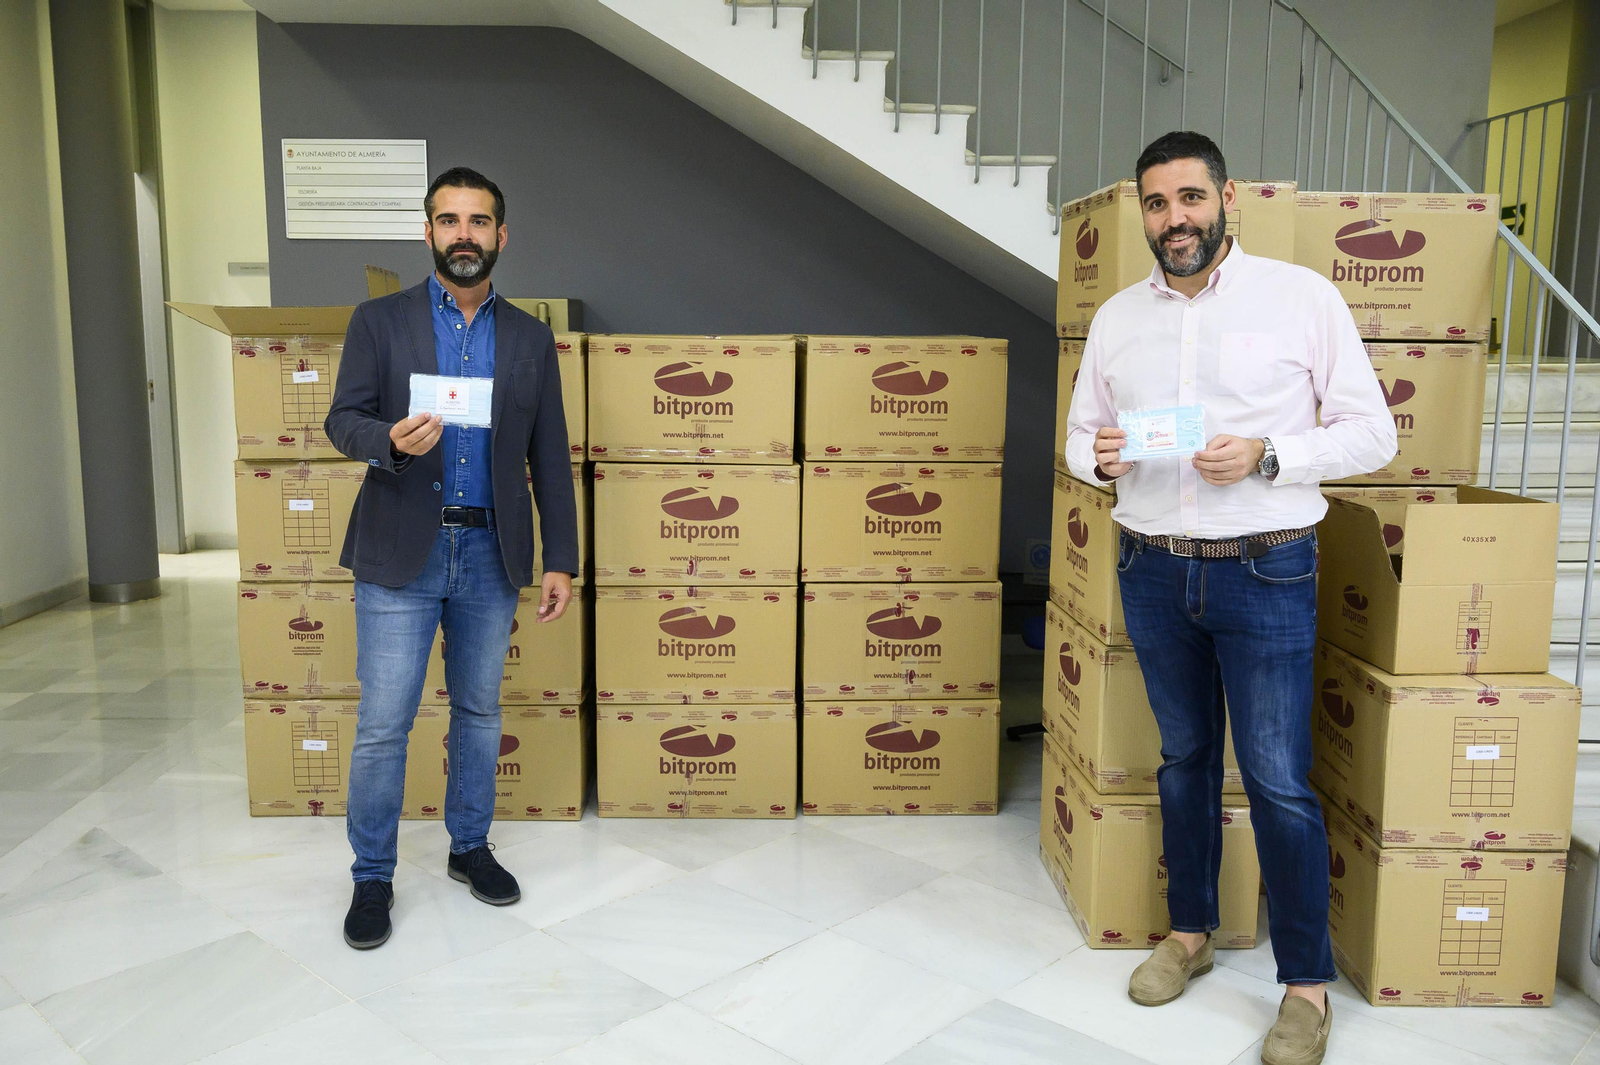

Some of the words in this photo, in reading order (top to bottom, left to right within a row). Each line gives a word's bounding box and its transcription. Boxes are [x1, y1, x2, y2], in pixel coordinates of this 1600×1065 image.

[359, 150, 386, 158] ALMERÍA
[1074, 261, 1099, 287] bitprom
[1332, 259, 1424, 287] bitprom
[654, 396, 733, 419] bitprom
[871, 395, 948, 418] bitprom
[661, 520, 739, 543] bitprom
[865, 516, 942, 538] bitprom
[1066, 540, 1088, 574] bitprom
[1342, 603, 1368, 626] bitprom
[289, 631, 324, 641] bitprom
[658, 639, 736, 660] bitprom
[865, 640, 942, 661] bitprom
[1058, 672, 1080, 713] bitprom
[1318, 709, 1353, 760] bitprom
[660, 757, 736, 778] bitprom
[864, 753, 940, 774] bitprom
